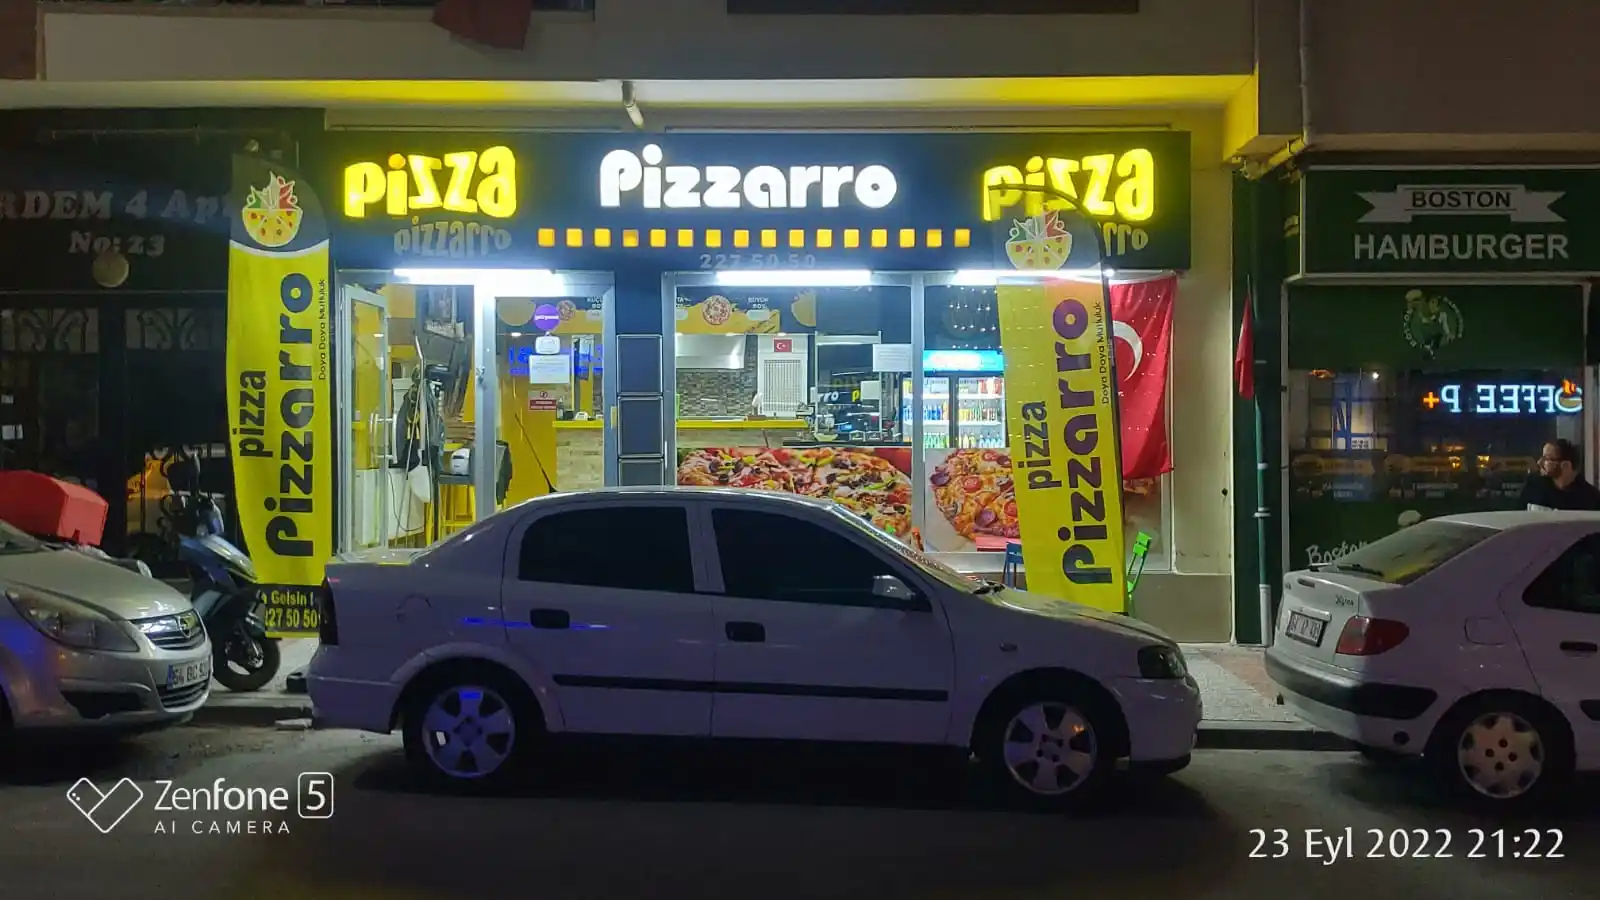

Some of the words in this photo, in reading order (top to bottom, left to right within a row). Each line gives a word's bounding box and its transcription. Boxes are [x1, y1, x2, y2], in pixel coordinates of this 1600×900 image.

[125, 189, 147, 218] 4
[344, 146, 516, 218] pizza
[600, 144, 897, 209] Pizzarro
[983, 148, 1154, 221] pizza
[1412, 191, 1511, 208] BOSTON
[393, 216, 512, 258] pizzarro
[700, 254, 742, 270] 227
[755, 254, 779, 270] 50
[788, 254, 816, 270] 50
[1354, 233, 1569, 260] HAMBURGER
[232, 370, 273, 457] pizza
[264, 272, 315, 557] Pizzarro
[1018, 400, 1062, 489] pizza
[1052, 298, 1113, 584] Pizzarro
[286, 608, 300, 628] 50
[303, 608, 318, 628] 50
